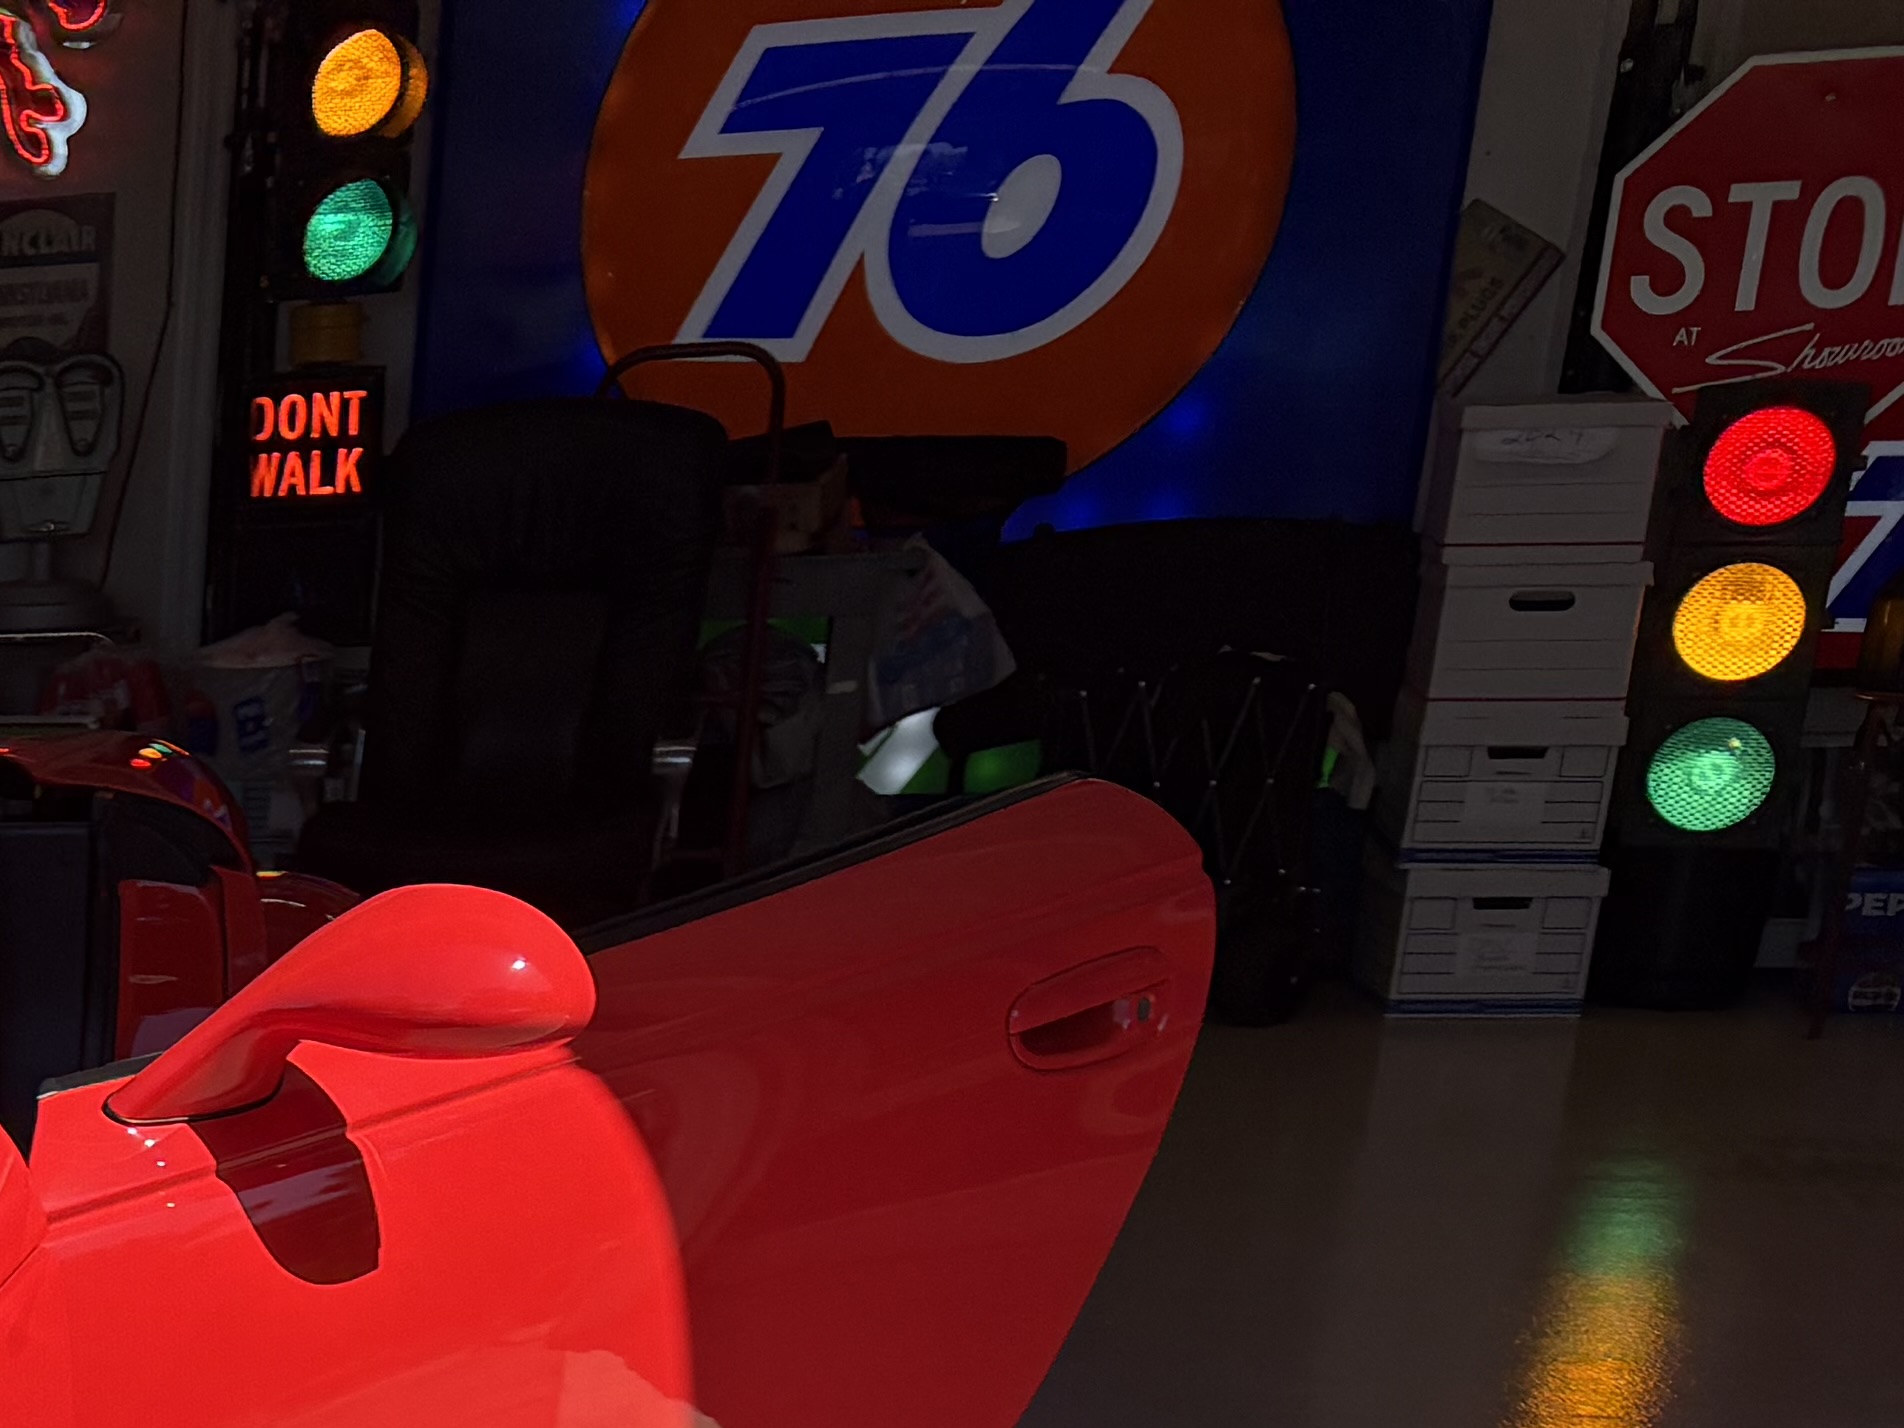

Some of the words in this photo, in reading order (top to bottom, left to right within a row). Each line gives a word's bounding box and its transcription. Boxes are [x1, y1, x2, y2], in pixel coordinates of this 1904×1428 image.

[672, 0, 1184, 364] 76
[1630, 175, 1904, 316] STO
[1671, 322, 1904, 394] Showroo
[1673, 327, 1701, 346] AT
[250, 390, 368, 441] DONT
[250, 447, 365, 498] WALK
